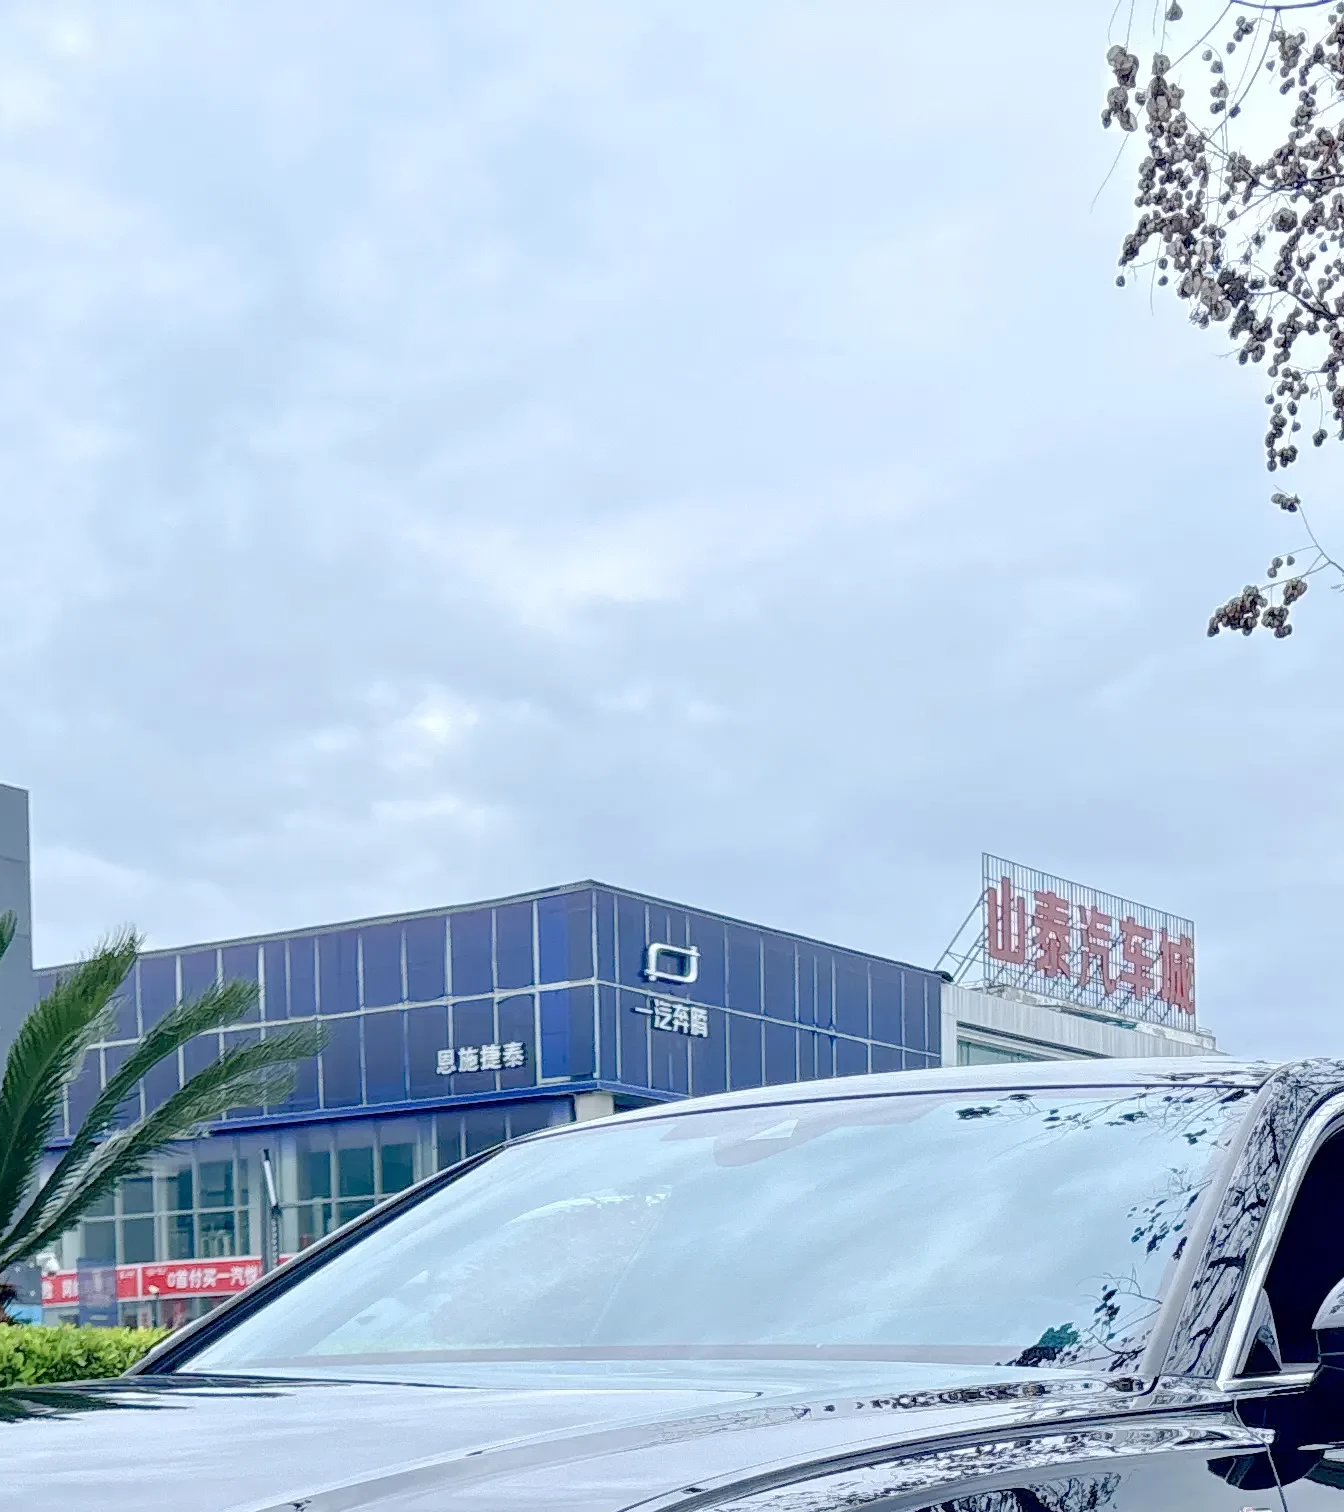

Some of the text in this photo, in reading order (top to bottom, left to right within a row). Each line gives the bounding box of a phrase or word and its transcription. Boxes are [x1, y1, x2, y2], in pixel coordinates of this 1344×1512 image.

[987, 875, 1195, 1016] 山泰汽车城
[436, 1041, 525, 1076] 恩施捷泰
